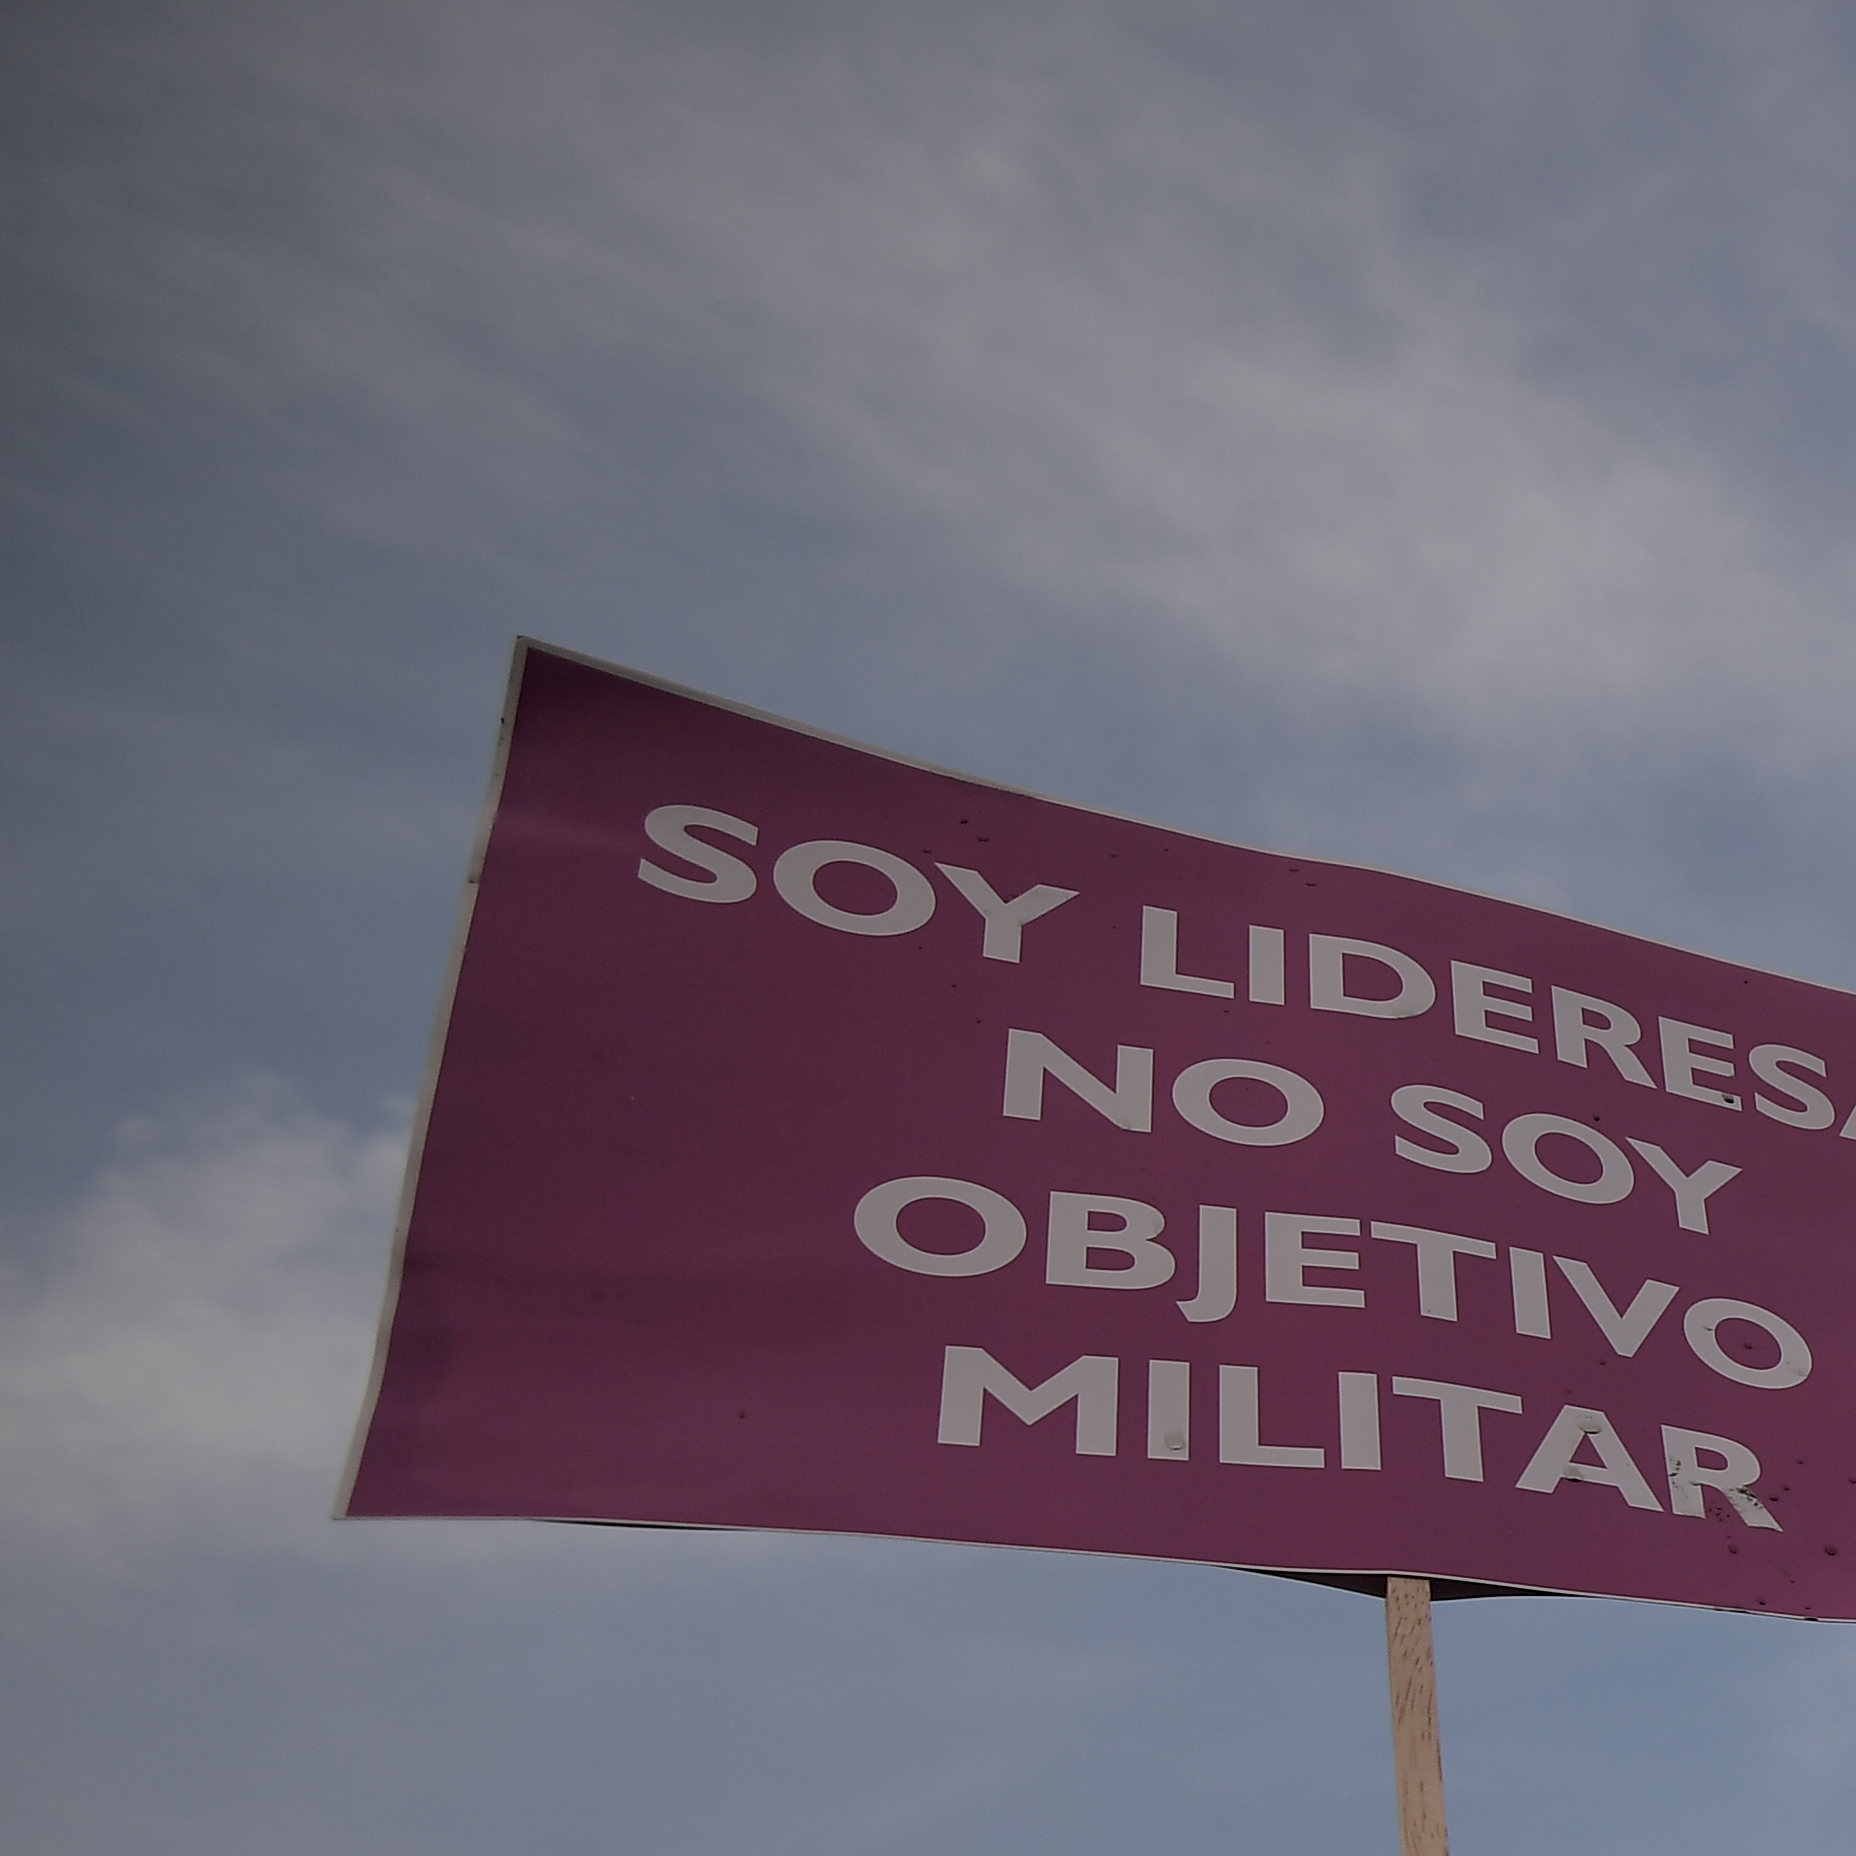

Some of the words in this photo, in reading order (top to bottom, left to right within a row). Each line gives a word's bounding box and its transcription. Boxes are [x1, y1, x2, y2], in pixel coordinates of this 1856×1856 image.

[638, 805, 1079, 964] SOY
[1002, 1028, 1324, 1147] NO
[1390, 1084, 1742, 1235] SOY
[853, 1176, 1813, 1389] OBJETIVO
[937, 1345, 1783, 1532] MILITAR
